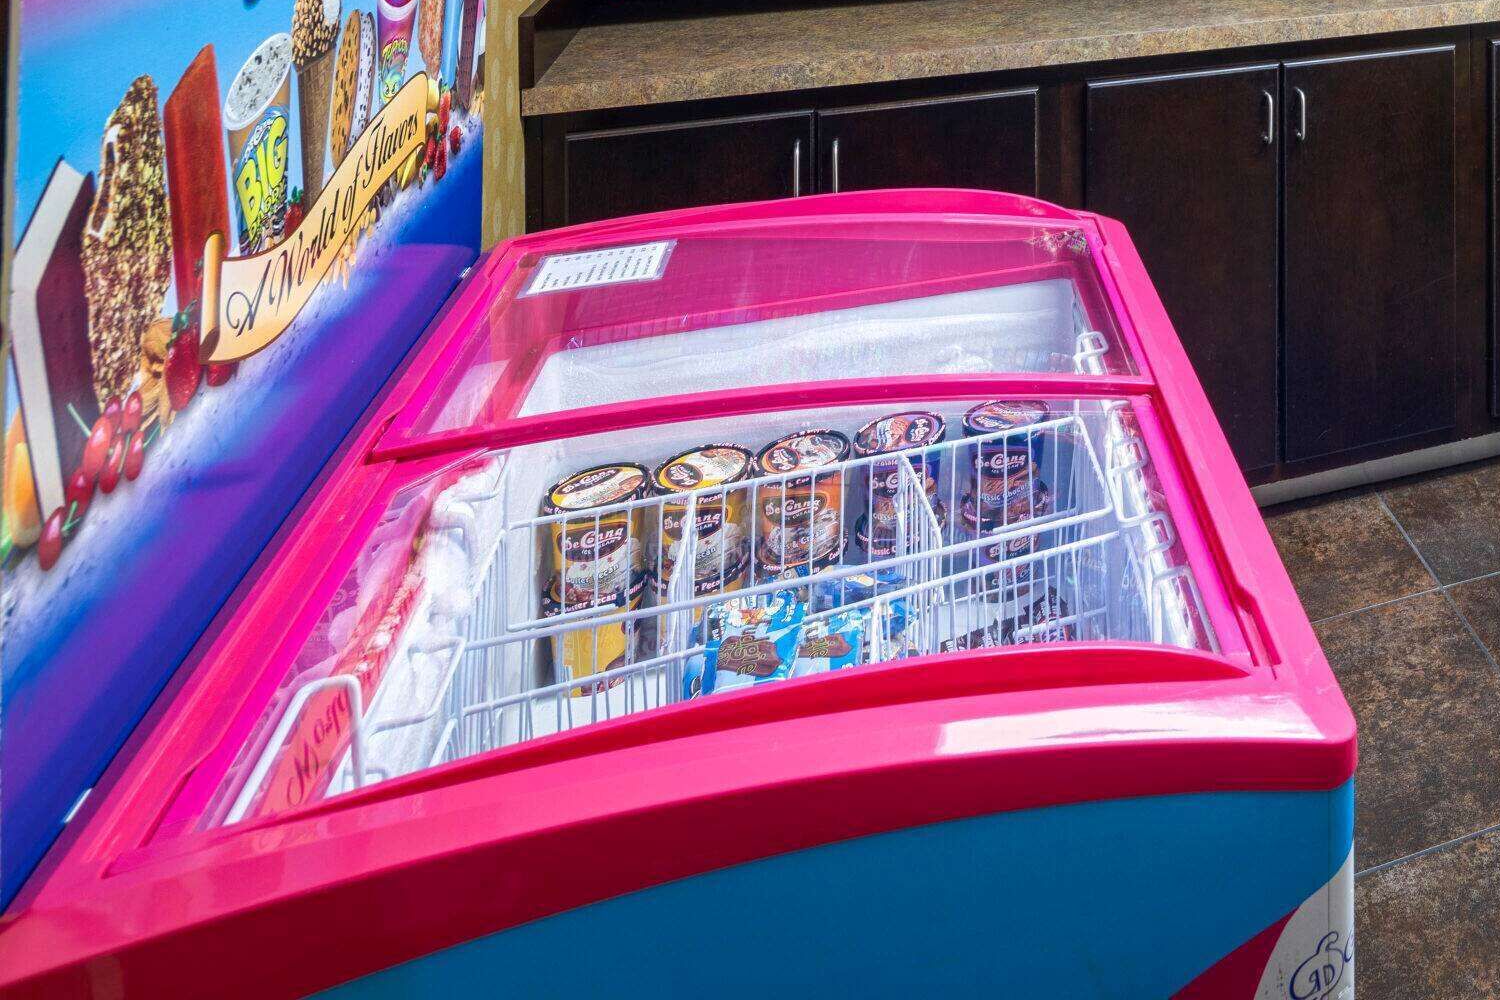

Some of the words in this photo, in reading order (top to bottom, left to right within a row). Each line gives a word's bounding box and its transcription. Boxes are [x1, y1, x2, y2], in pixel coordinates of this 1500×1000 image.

[226, 270, 273, 338] A
[273, 210, 337, 320] World
[341, 172, 363, 247] of
[361, 109, 420, 191] Flavors
[236, 115, 288, 241] BIG
